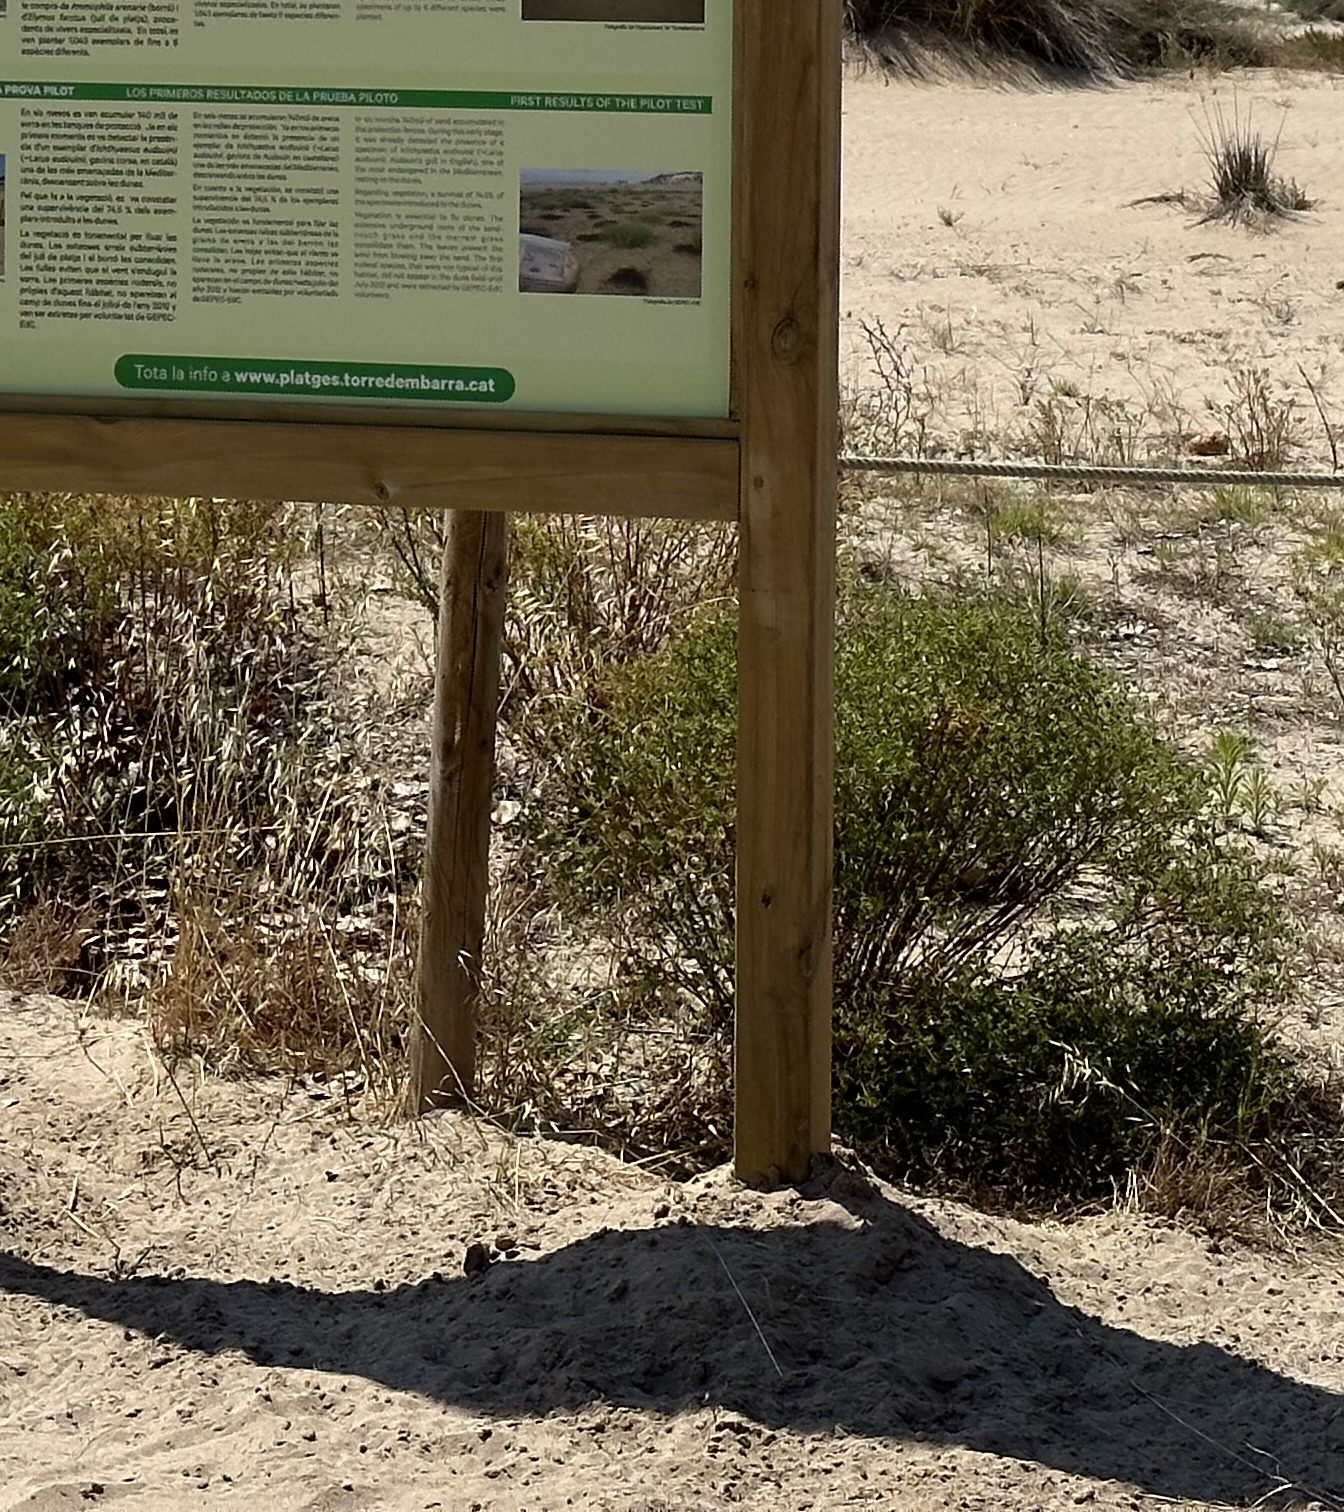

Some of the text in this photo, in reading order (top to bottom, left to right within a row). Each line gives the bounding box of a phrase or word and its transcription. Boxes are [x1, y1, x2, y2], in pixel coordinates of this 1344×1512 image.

[5, 85, 41, 95] PROVA
[43, 86, 74, 96] PILOT
[126, 88, 398, 103] LOS PRIMEROS RESULTADOS DE LA PRUEBA PILOTO
[511, 97, 703, 110] FIRST RESULTS OF THE PILOT TEST
[134, 364, 495, 393] Tota la info a www.platges.torredembarra.cat
